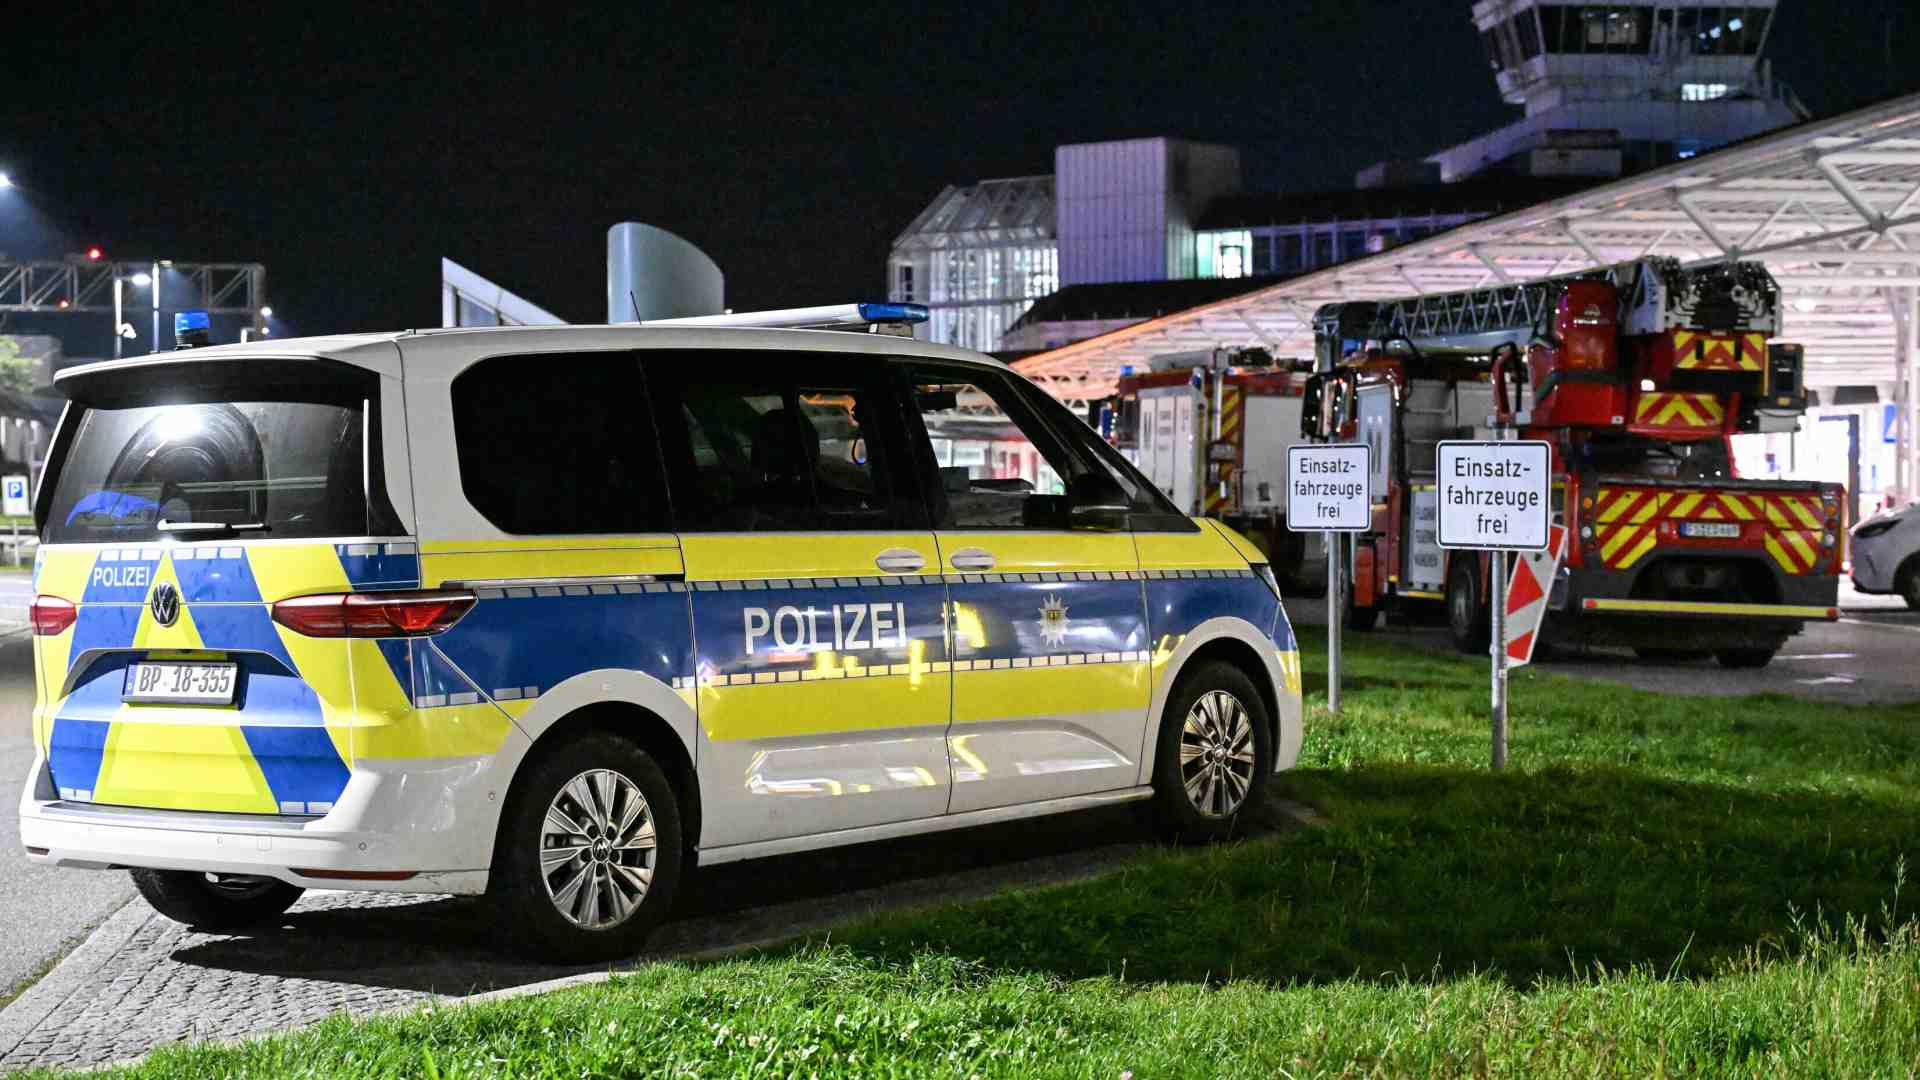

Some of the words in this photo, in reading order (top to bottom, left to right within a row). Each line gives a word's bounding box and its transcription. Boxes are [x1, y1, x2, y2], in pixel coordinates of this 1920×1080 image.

[1300, 458, 1357, 473] Einsatz-
[1455, 457, 1531, 477] Einsatz-
[1295, 481, 1363, 500] fahrzeuge
[1447, 486, 1539, 511] fahrzeuge
[1317, 502, 1341, 518] frei
[1477, 514, 1508, 534] frei
[93, 566, 150, 587] POLIZEI
[743, 602, 907, 655] POLIZEI
[138, 666, 162, 692] BP
[170, 665, 232, 693] 18-355
